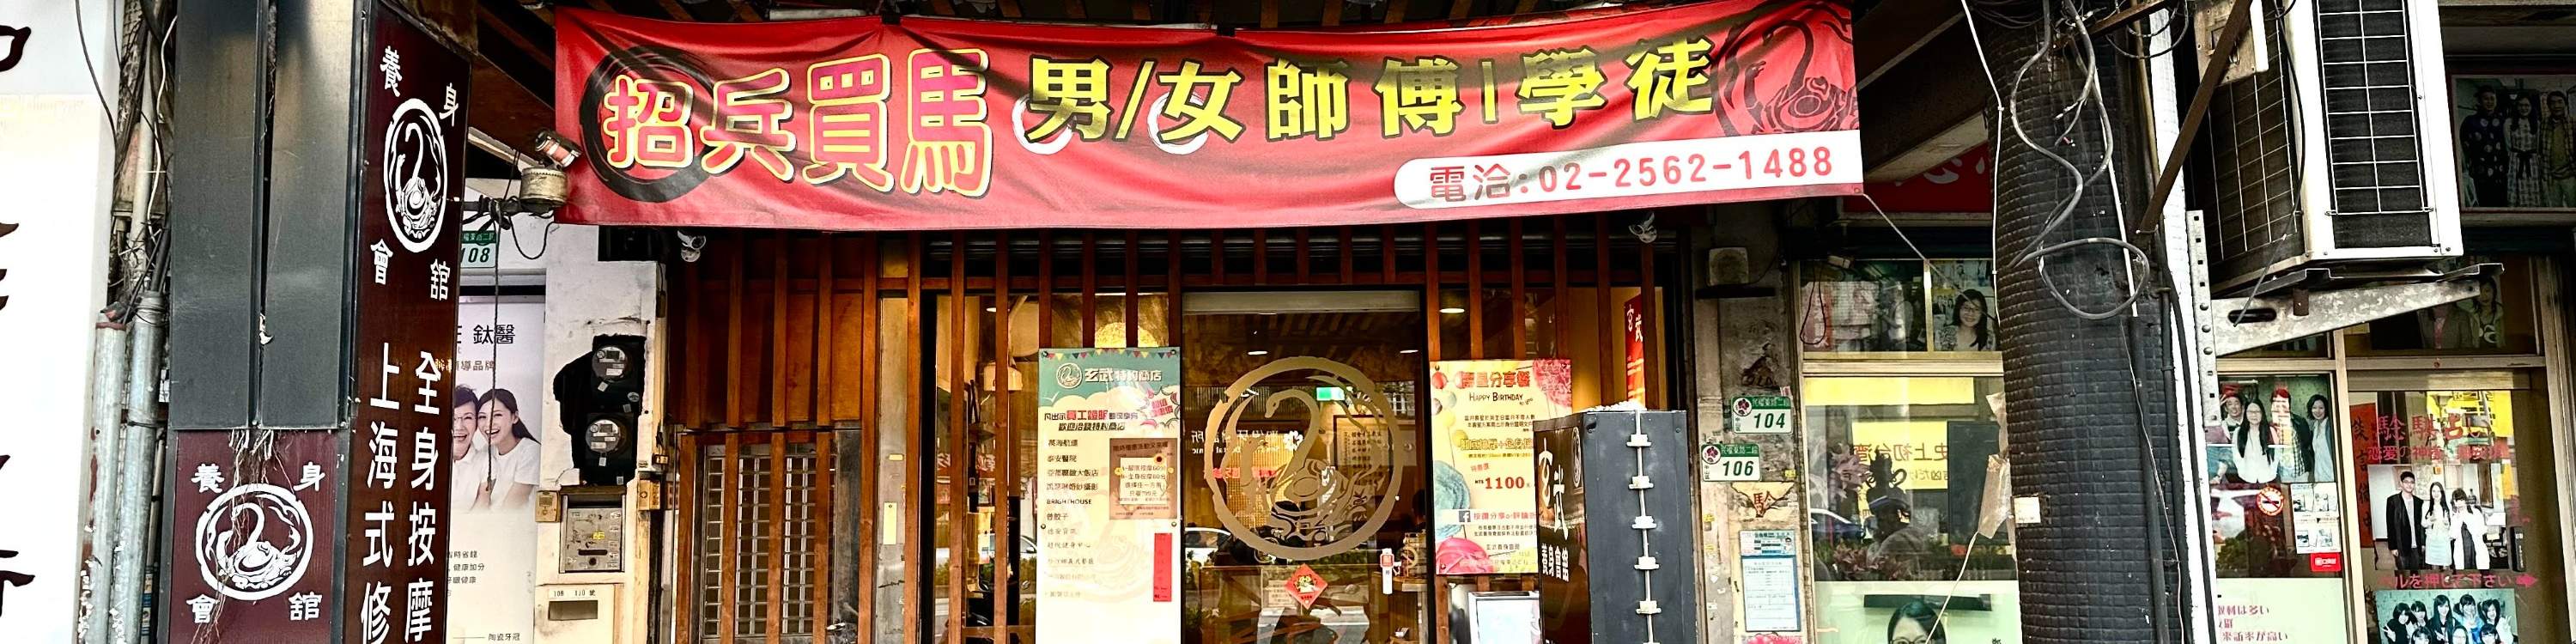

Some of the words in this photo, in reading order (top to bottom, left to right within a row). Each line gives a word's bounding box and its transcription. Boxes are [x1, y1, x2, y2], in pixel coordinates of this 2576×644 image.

[602, 47, 993, 199] 招兵買馬
[461, 247, 490, 263] 108
[1753, 412, 1785, 428] 104
[1722, 460, 1754, 476] 106
[404, 350, 441, 643] 全身按摩
